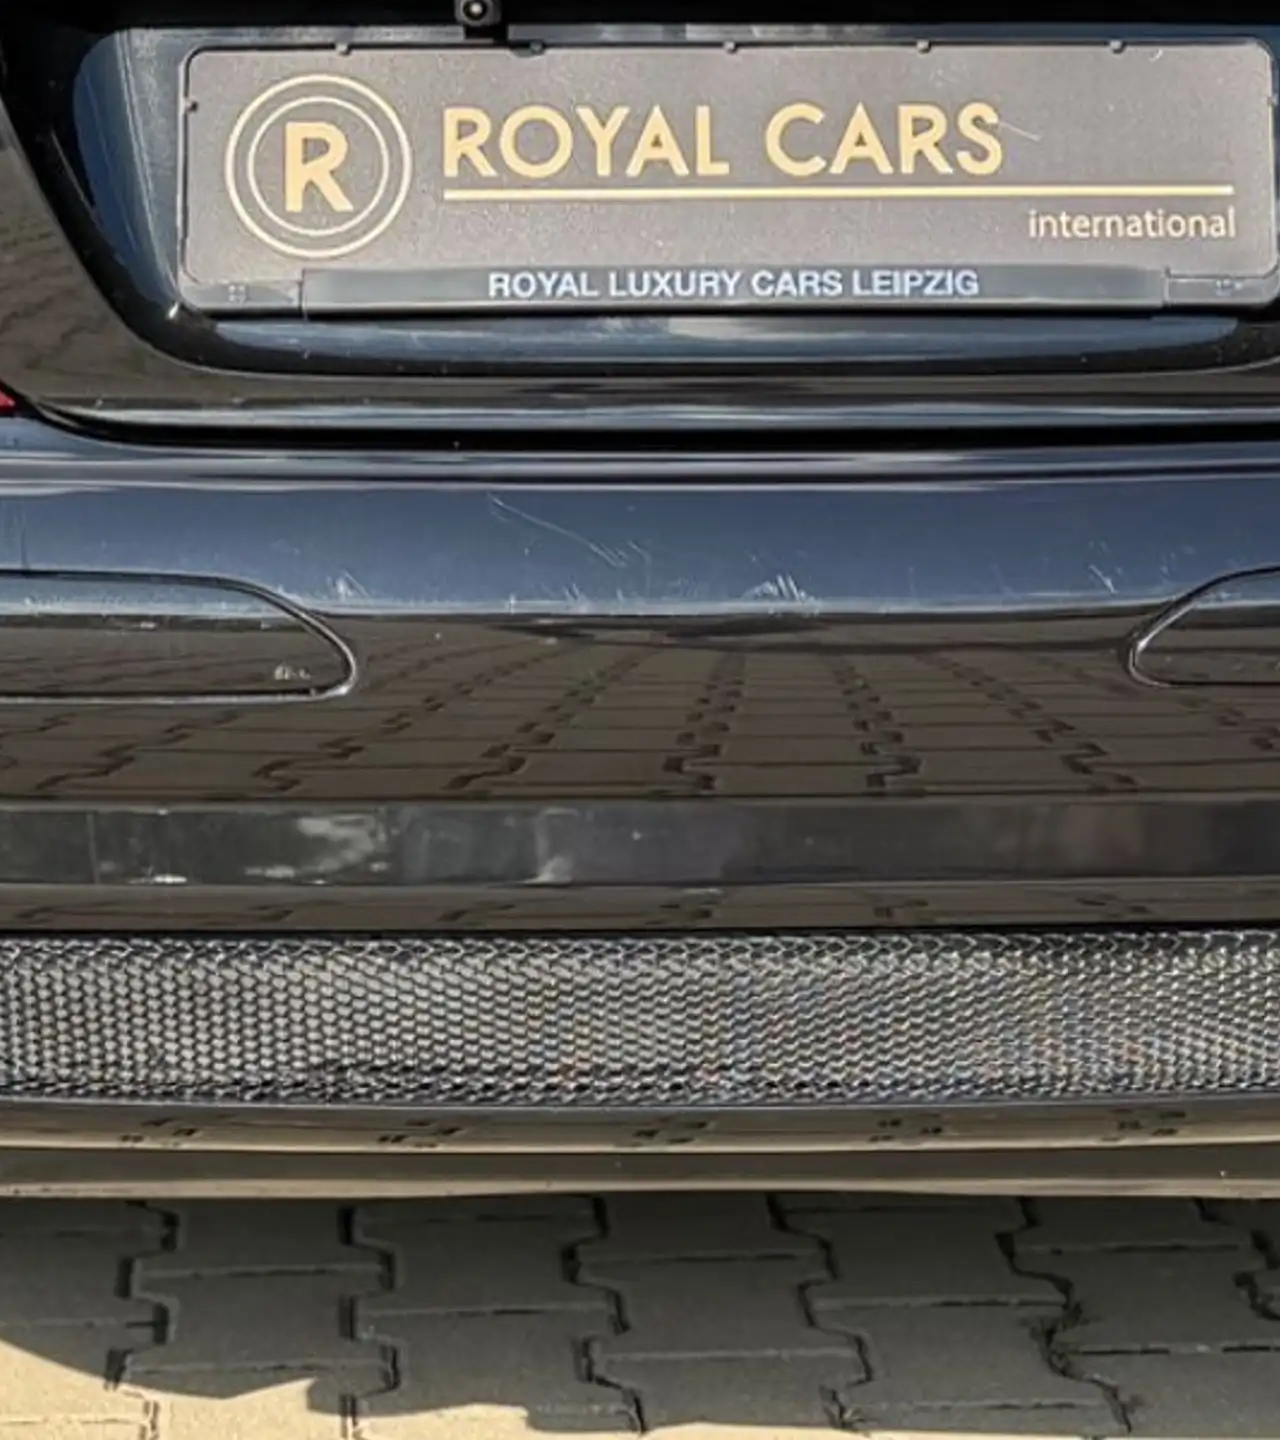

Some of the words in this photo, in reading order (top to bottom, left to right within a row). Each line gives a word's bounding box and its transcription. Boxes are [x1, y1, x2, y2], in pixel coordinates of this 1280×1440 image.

[284, 121, 354, 213] R
[442, 105, 732, 178] ROYAL
[764, 101, 1006, 177] CARS
[1026, 206, 1238, 242] international
[487, 268, 600, 300] ROYAL
[607, 268, 742, 300] LUXURY
[750, 268, 845, 300] CARS
[851, 268, 981, 300] LEIPZIG
